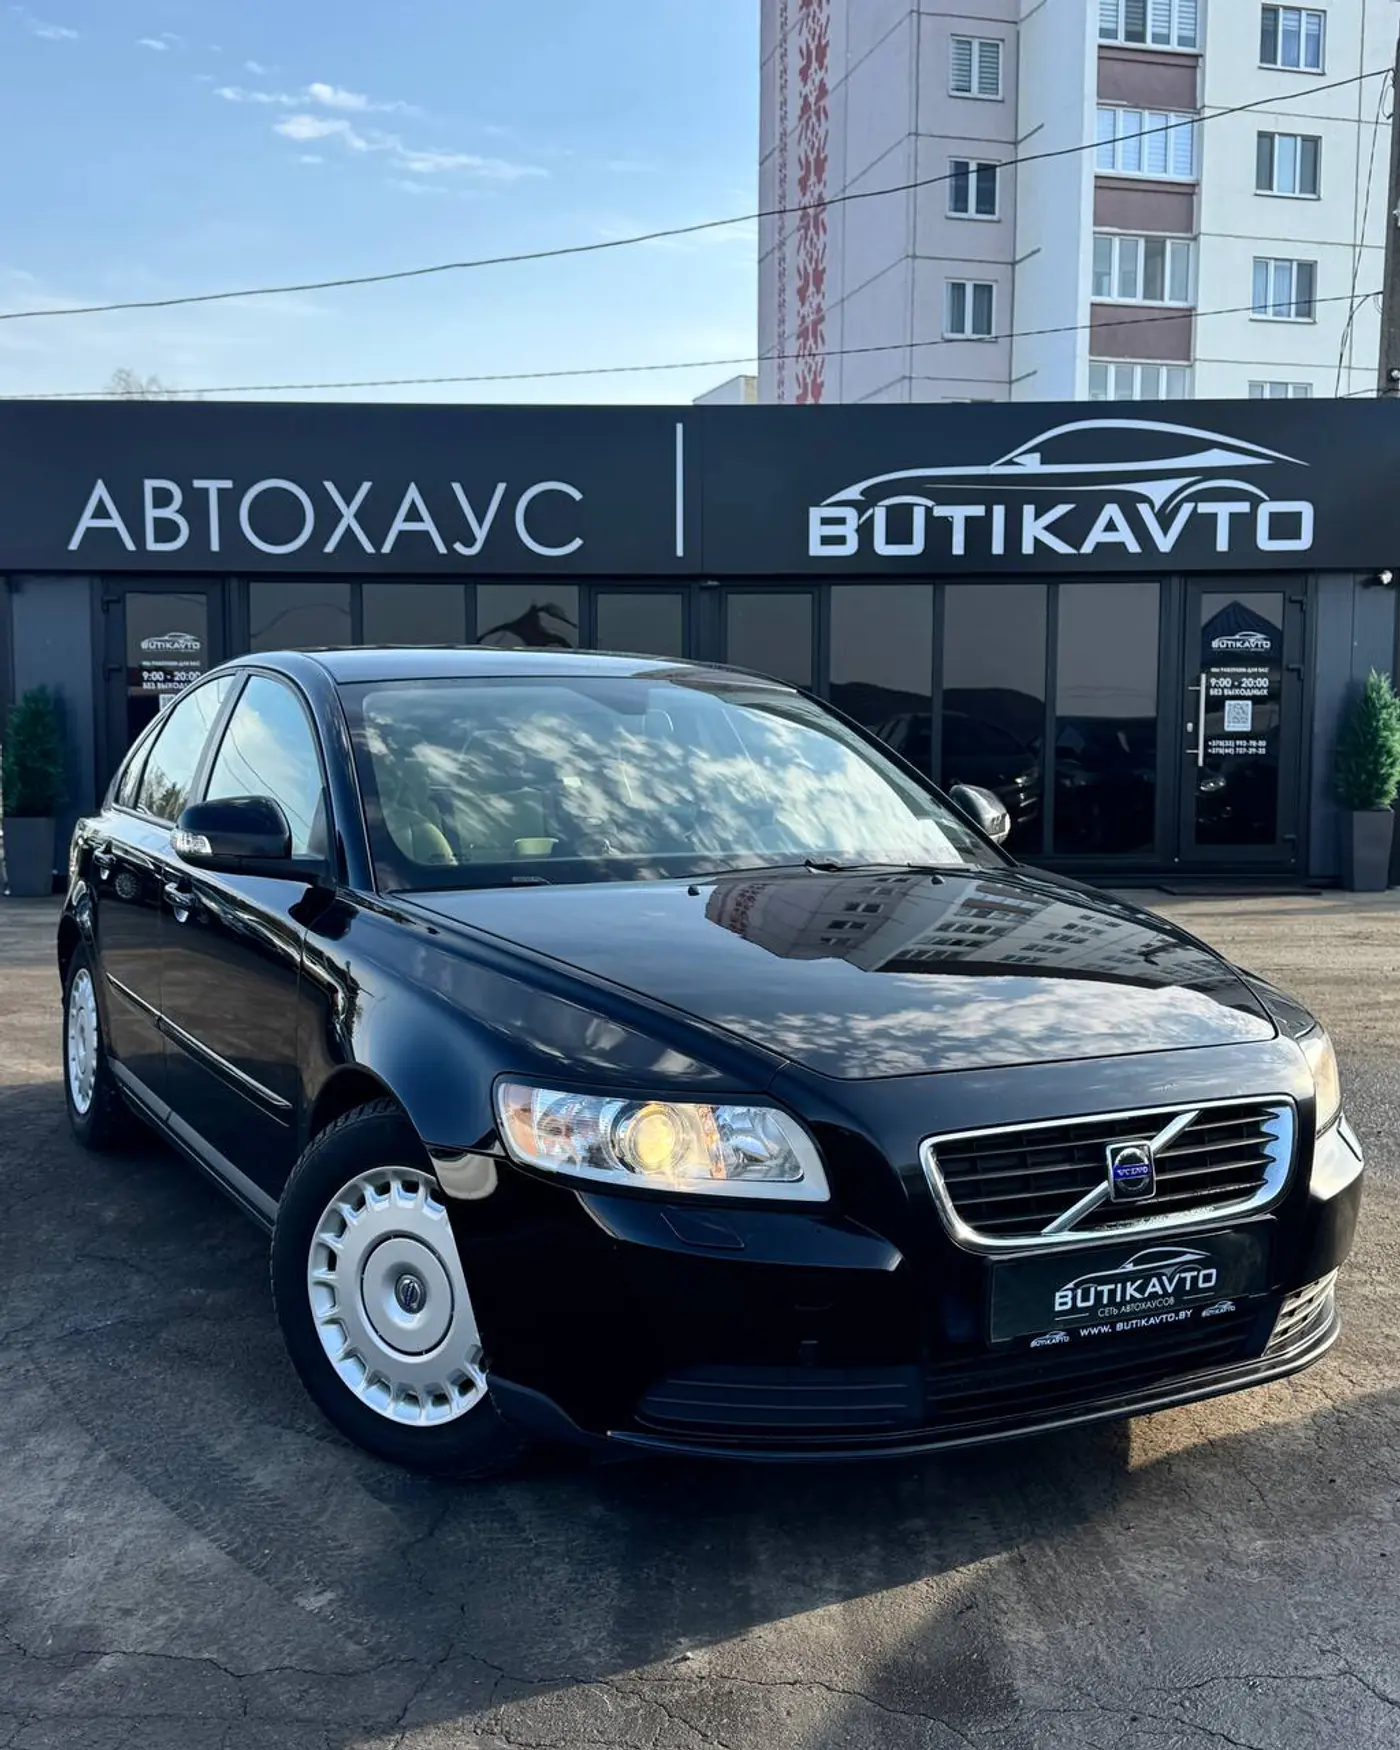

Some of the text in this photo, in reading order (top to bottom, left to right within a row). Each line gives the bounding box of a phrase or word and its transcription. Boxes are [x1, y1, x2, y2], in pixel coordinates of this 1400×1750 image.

[67, 478, 585, 557] АВТОХАУС
[808, 500, 1314, 557] BUTIKAVTO
[1211, 640, 1271, 649] BUTIKAVTO
[142, 671, 164, 681] 9:00
[1210, 677, 1232, 688] 9:00
[1241, 677, 1269, 688] 20:00
[1209, 688, 1268, 697] БЕЗ ВЫХОДНЫХ
[1116, 1166, 1149, 1176] VOLVO
[1054, 1268, 1217, 1312] BUTIKAVTO
[1097, 1296, 1176, 1318] СЕТЬ АВТОХАУСОВ
[1080, 1310, 1194, 1337] WWW. BUTIKAVTO.BY
